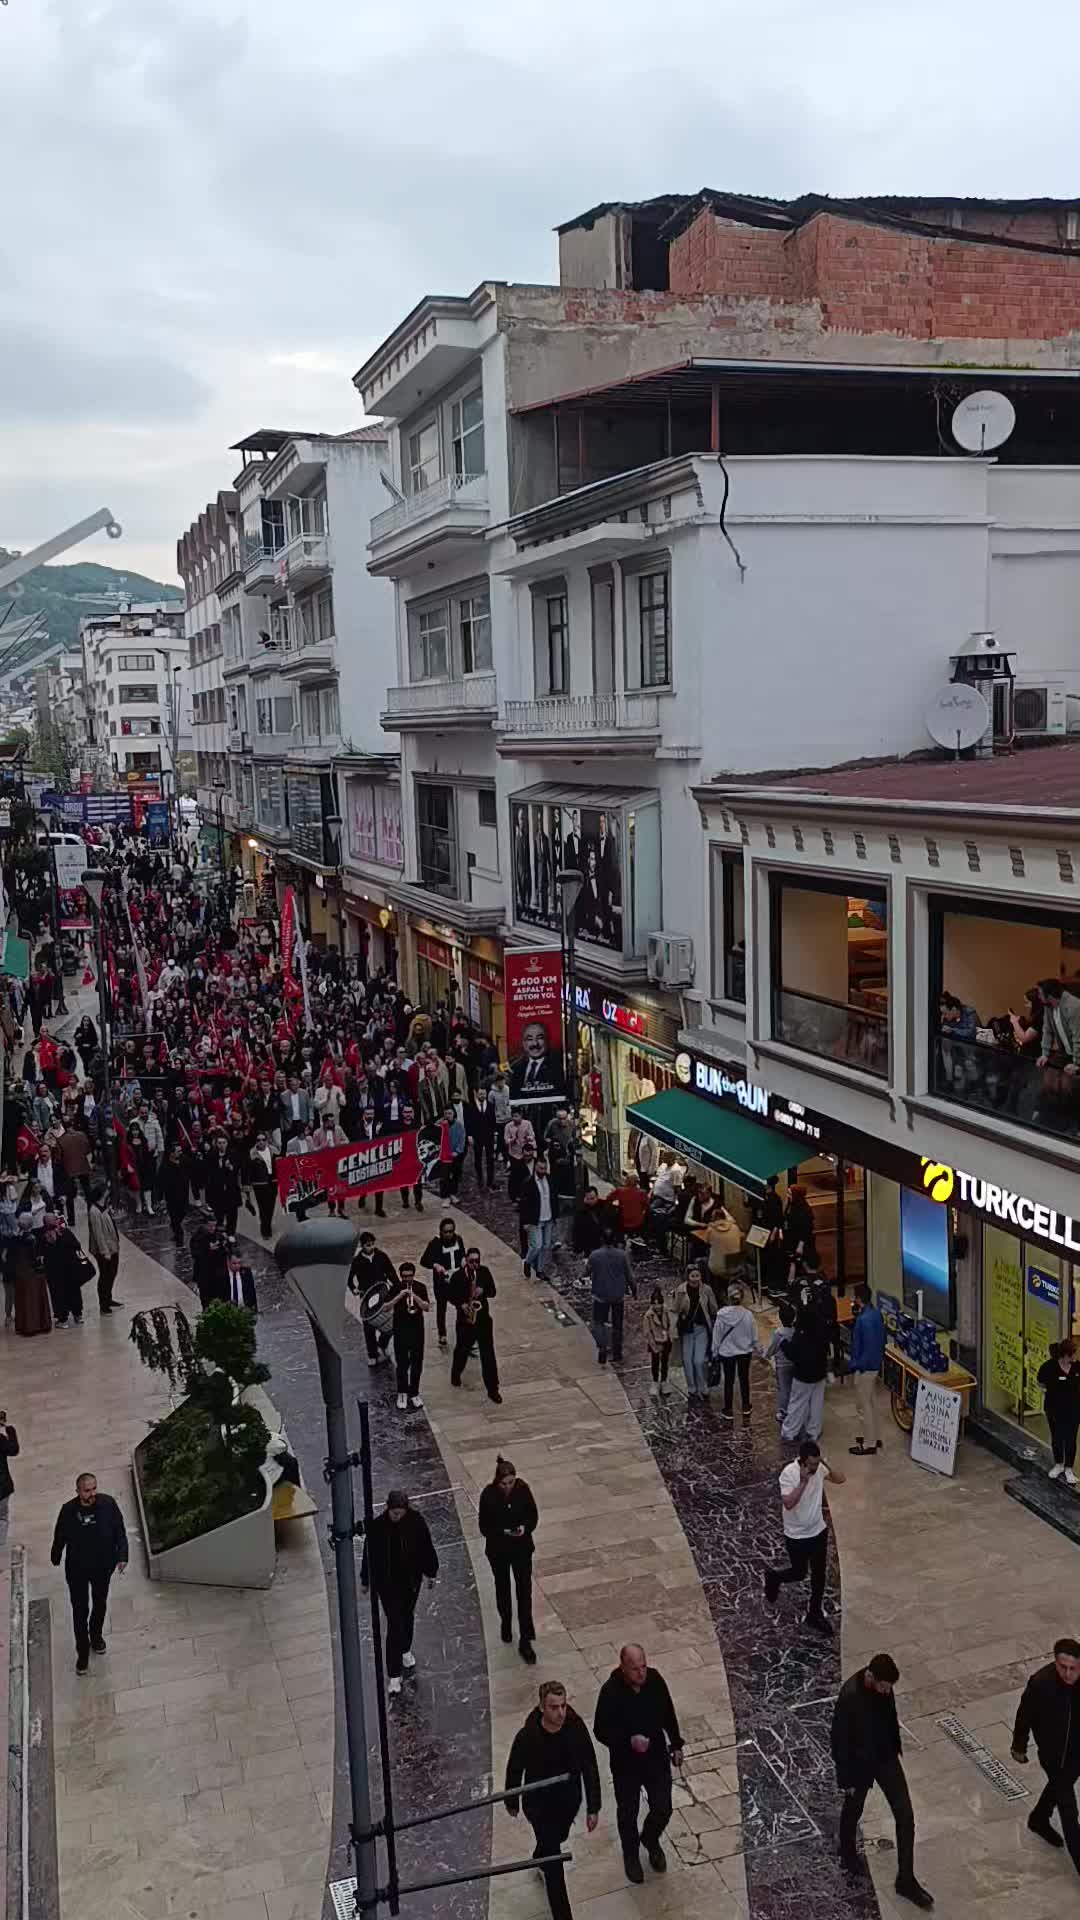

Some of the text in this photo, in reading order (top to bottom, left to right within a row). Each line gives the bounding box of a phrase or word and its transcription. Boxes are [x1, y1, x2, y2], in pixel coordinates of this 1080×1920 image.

[511, 975, 557, 987] 2.600 KM
[696, 1061, 768, 1117] BUN the BUN
[955, 1170, 1080, 1252] TURKCELL
